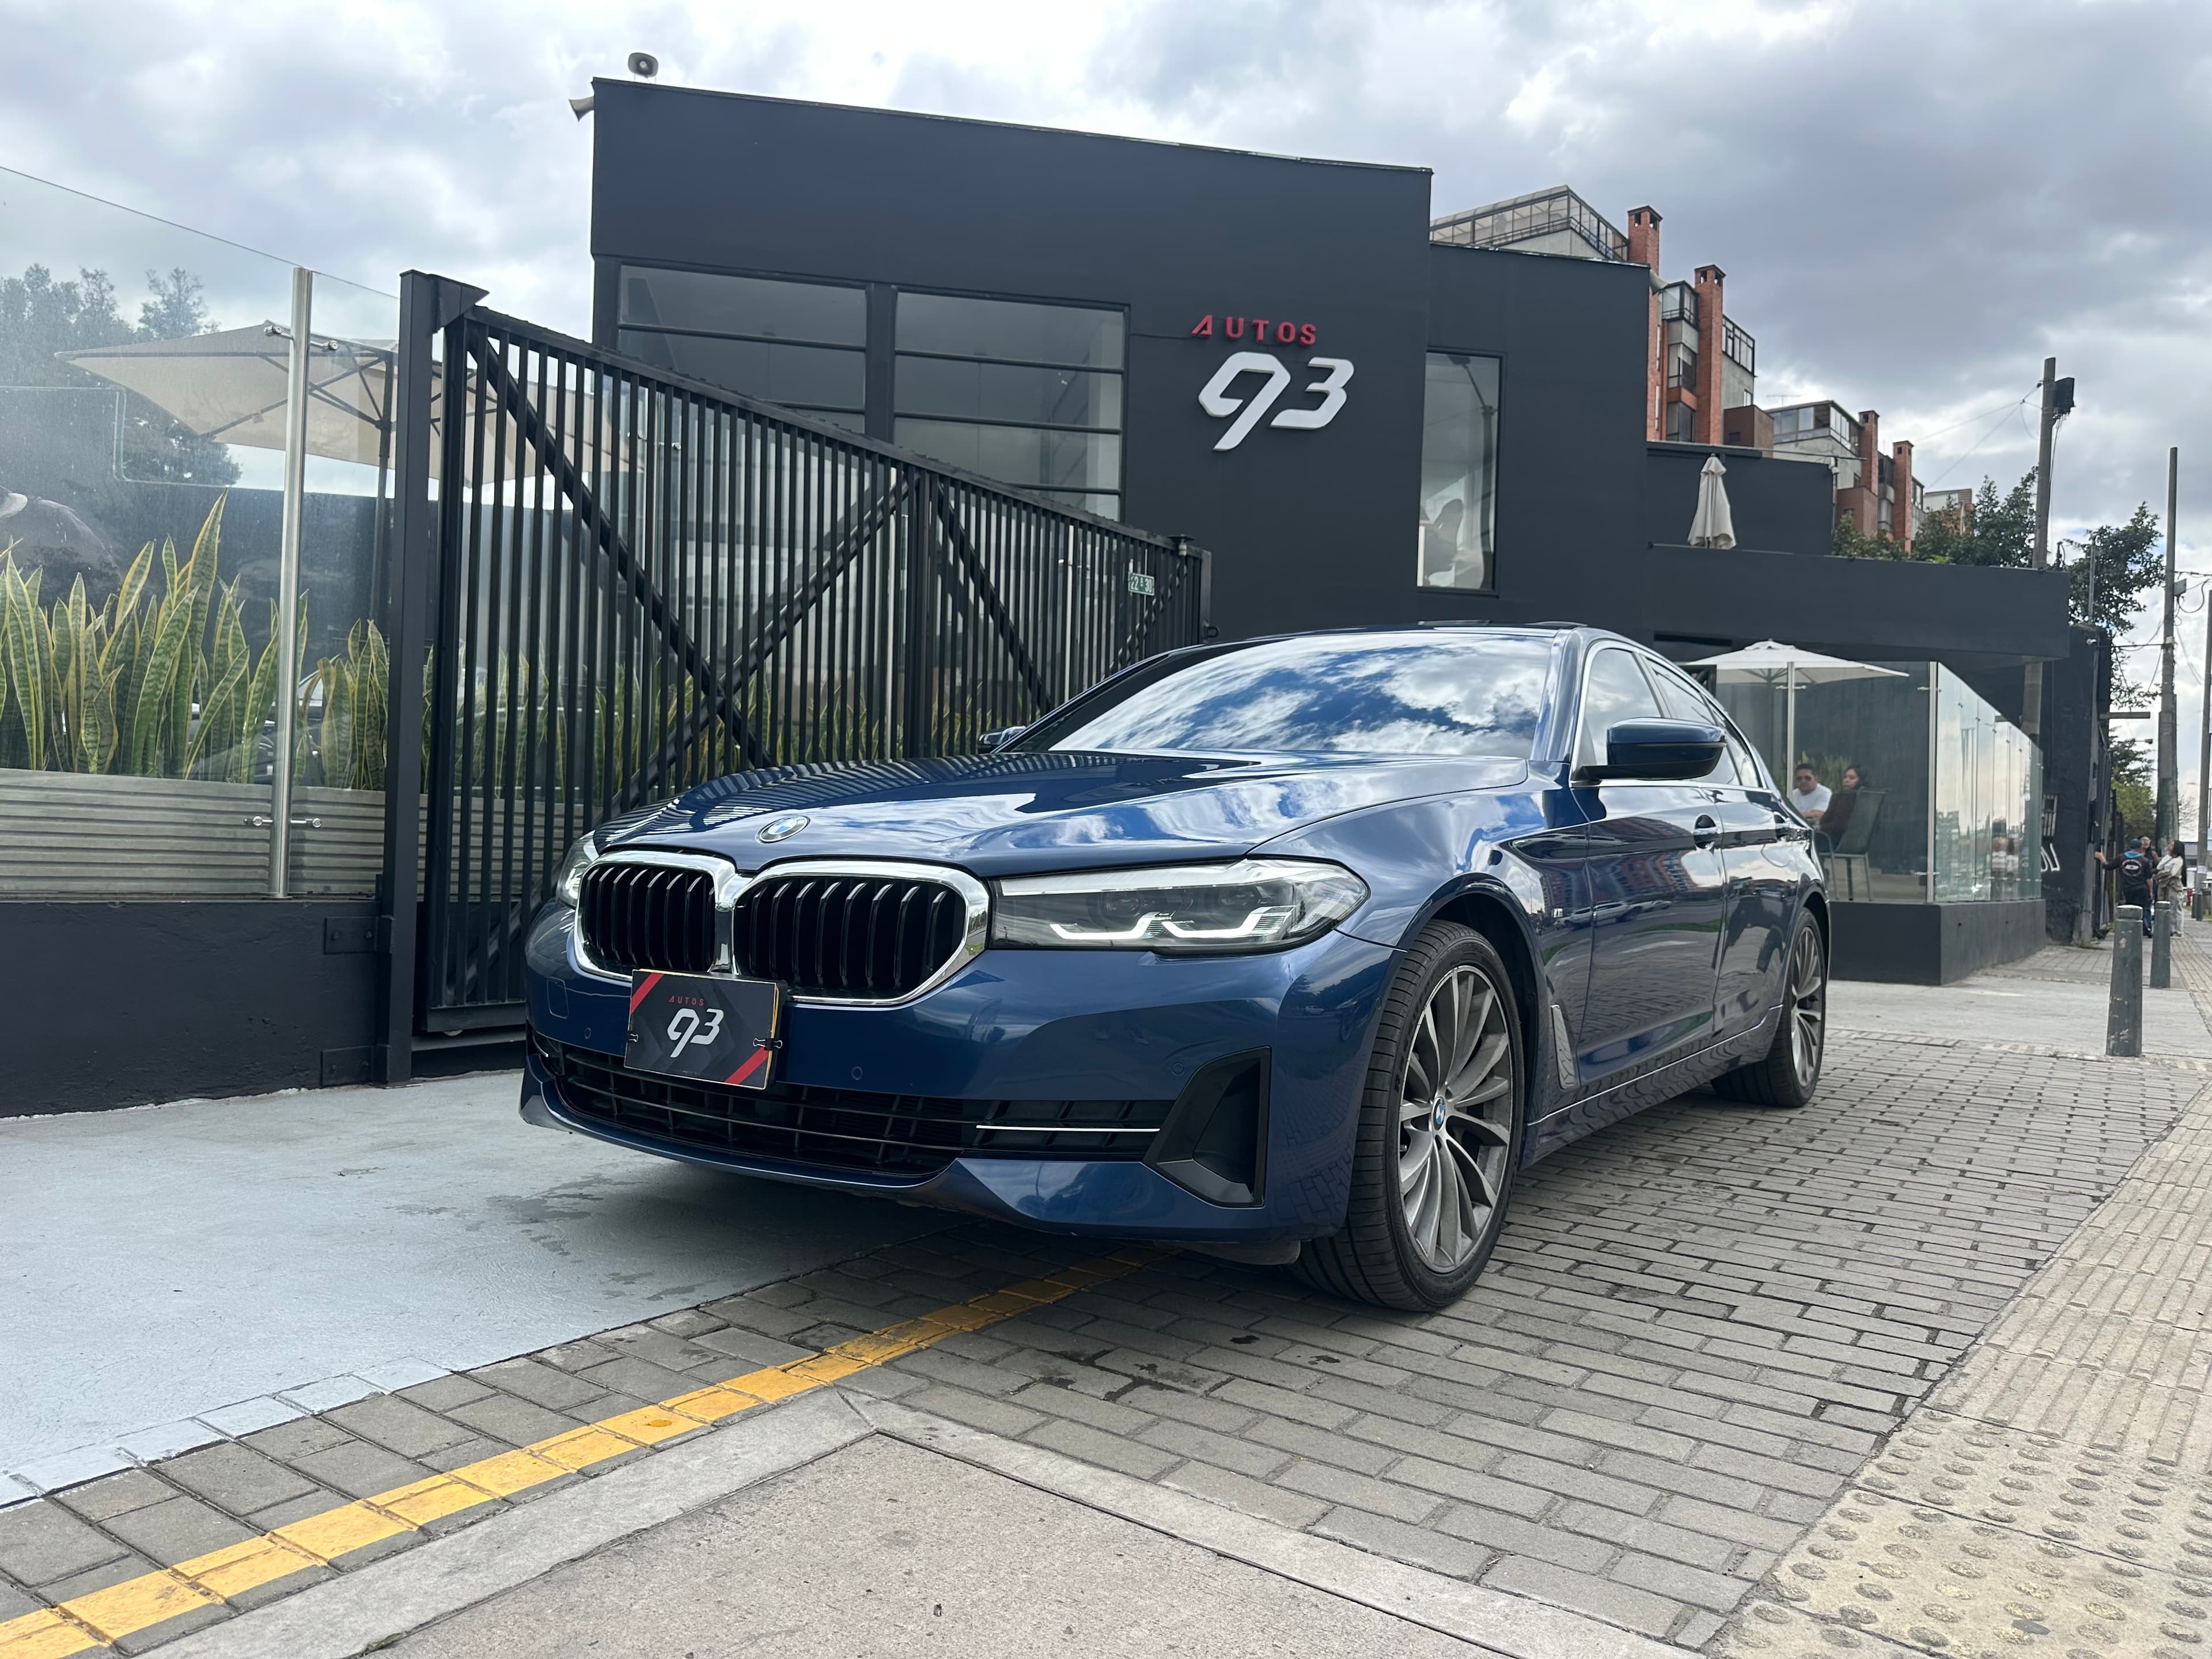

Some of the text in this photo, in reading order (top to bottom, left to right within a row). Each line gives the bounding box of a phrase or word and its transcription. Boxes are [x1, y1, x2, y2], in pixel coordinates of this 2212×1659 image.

[1191, 315, 1316, 345] AUTOS
[1198, 351, 1354, 451] 93
[668, 995, 704, 1006] AUTOS
[667, 1008, 724, 1058] 93
